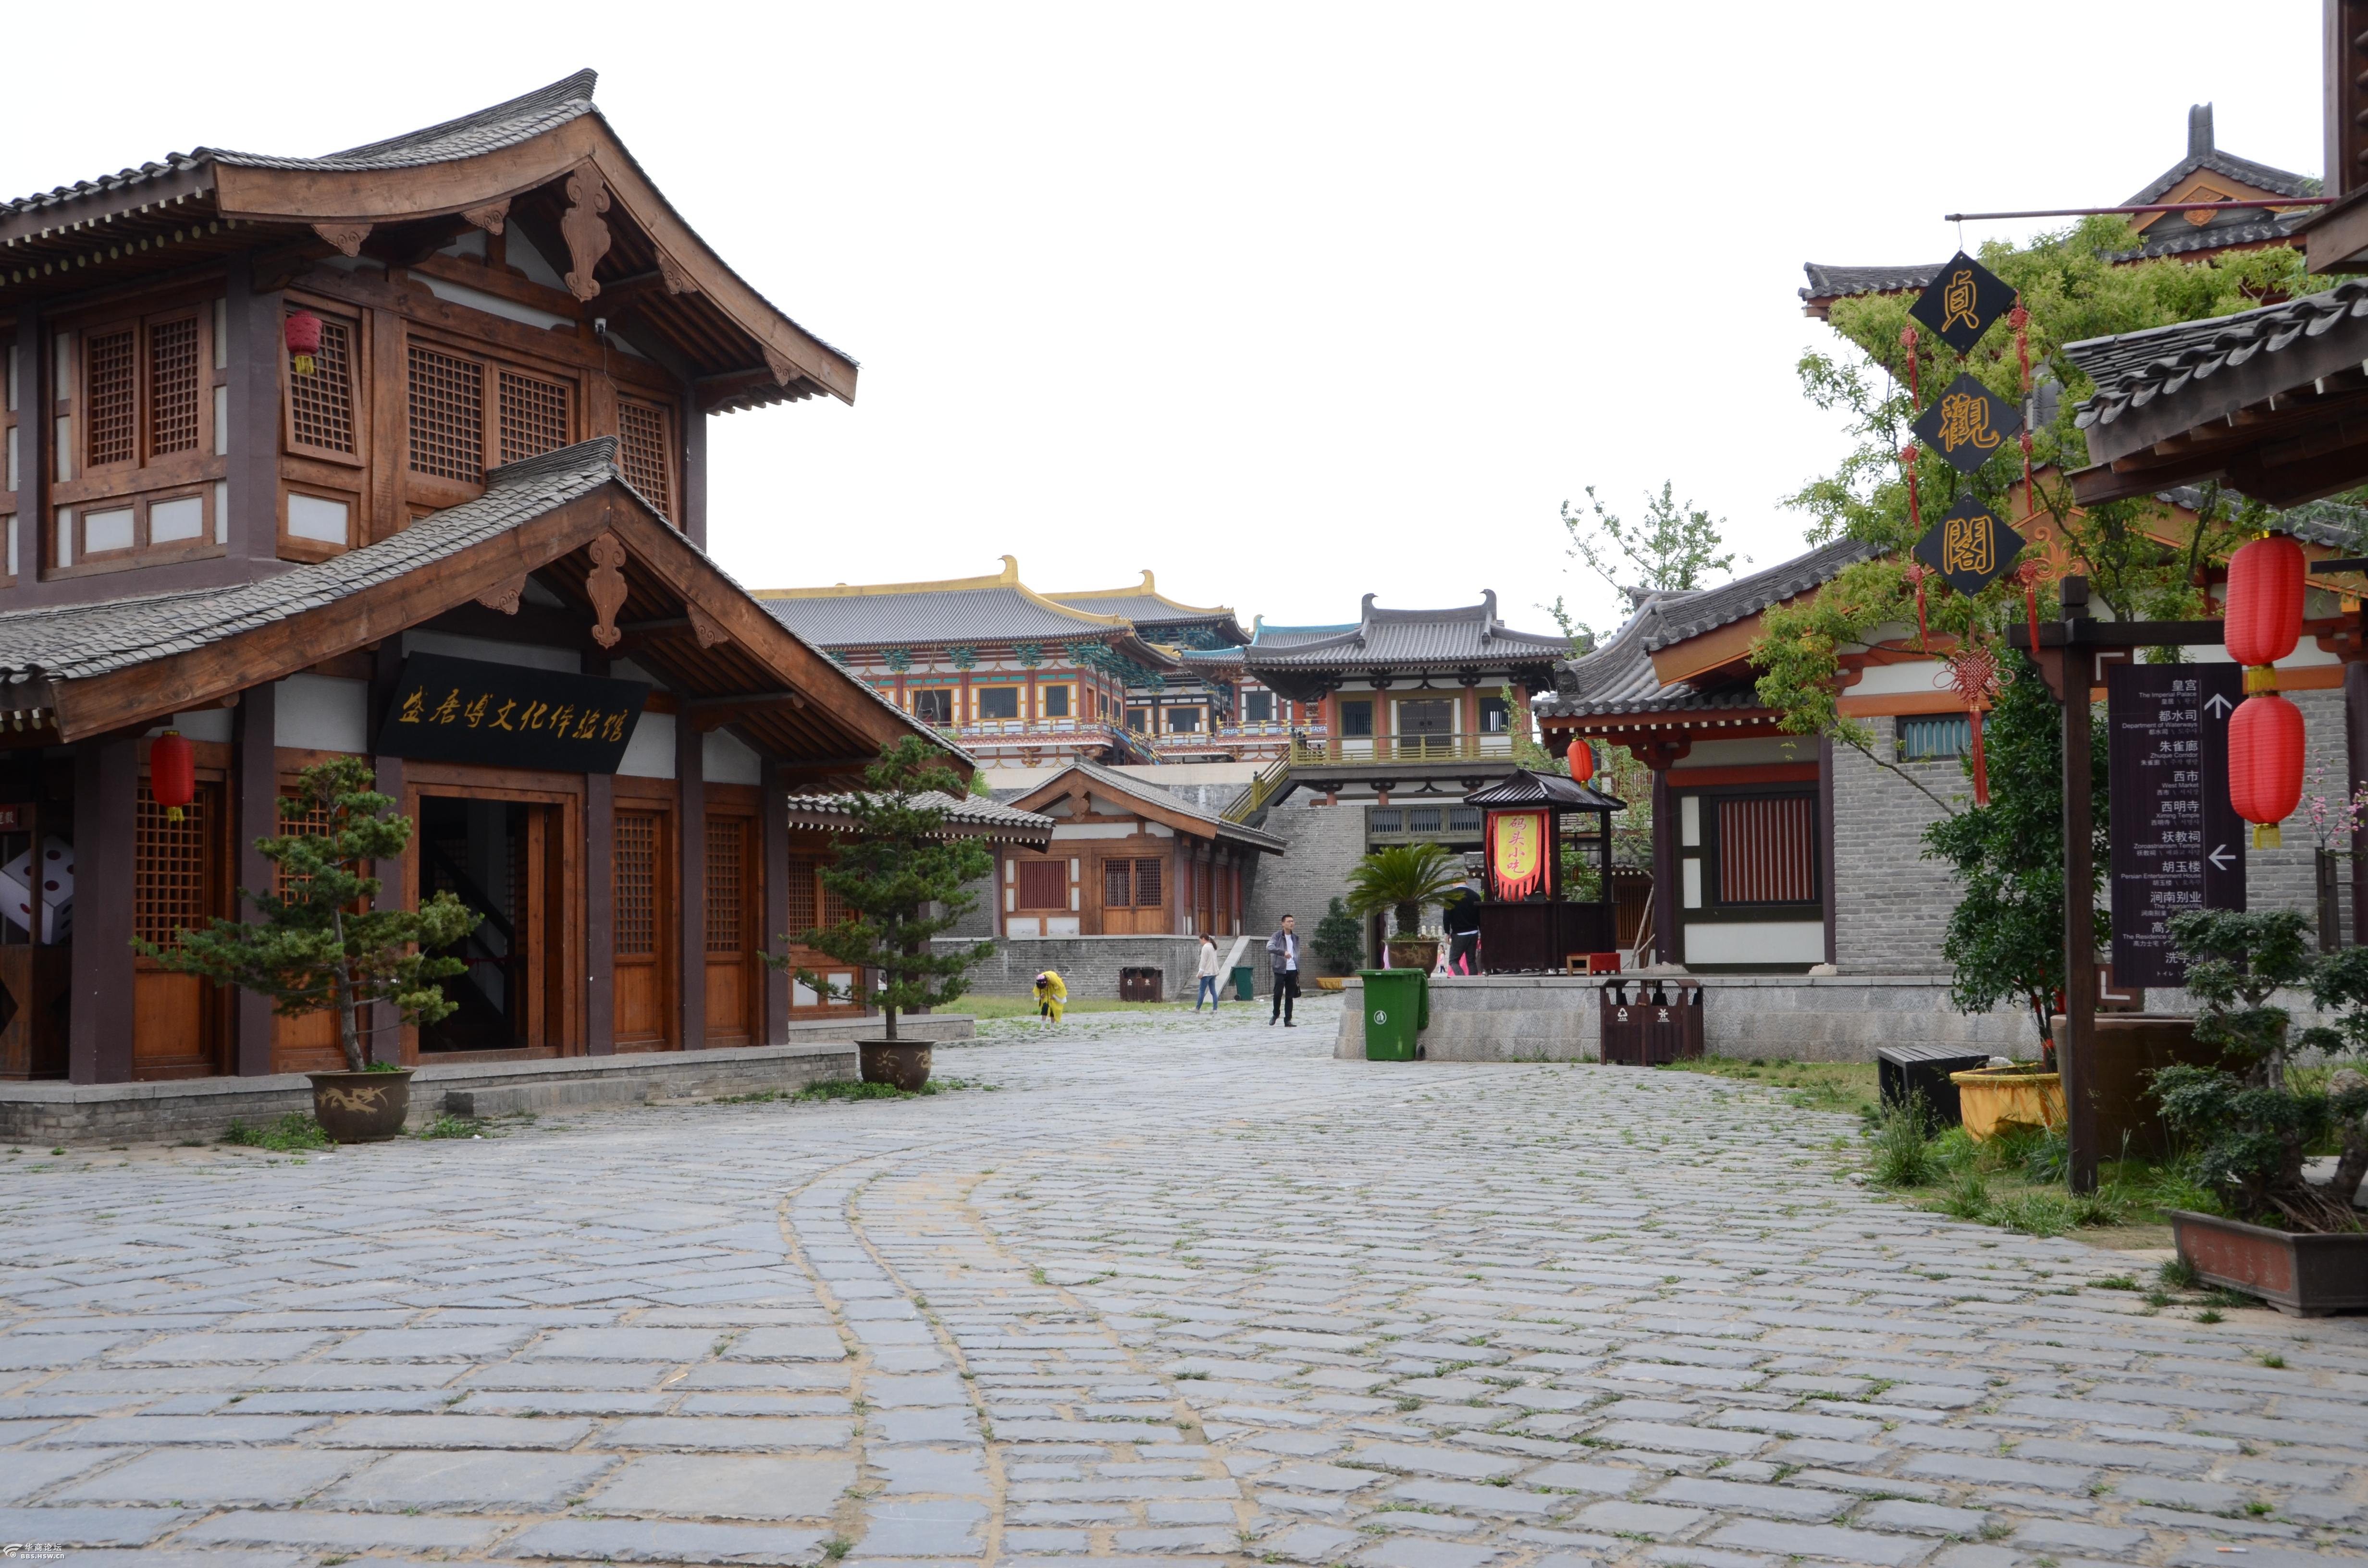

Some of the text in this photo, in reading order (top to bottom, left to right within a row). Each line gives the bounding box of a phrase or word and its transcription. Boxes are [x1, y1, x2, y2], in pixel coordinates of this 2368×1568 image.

[2172, 679, 2197, 691] 皇宫
[2158, 710, 2197, 722] 都水司
[2159, 740, 2198, 752] 朱雀廊
[2173, 770, 2199, 782] 西市
[2161, 800, 2199, 812] 西明寺
[1507, 817, 1527, 873] 码头小吃
[2162, 860, 2201, 872] 胡玉楼
[2150, 891, 2202, 903] 涧南别业
